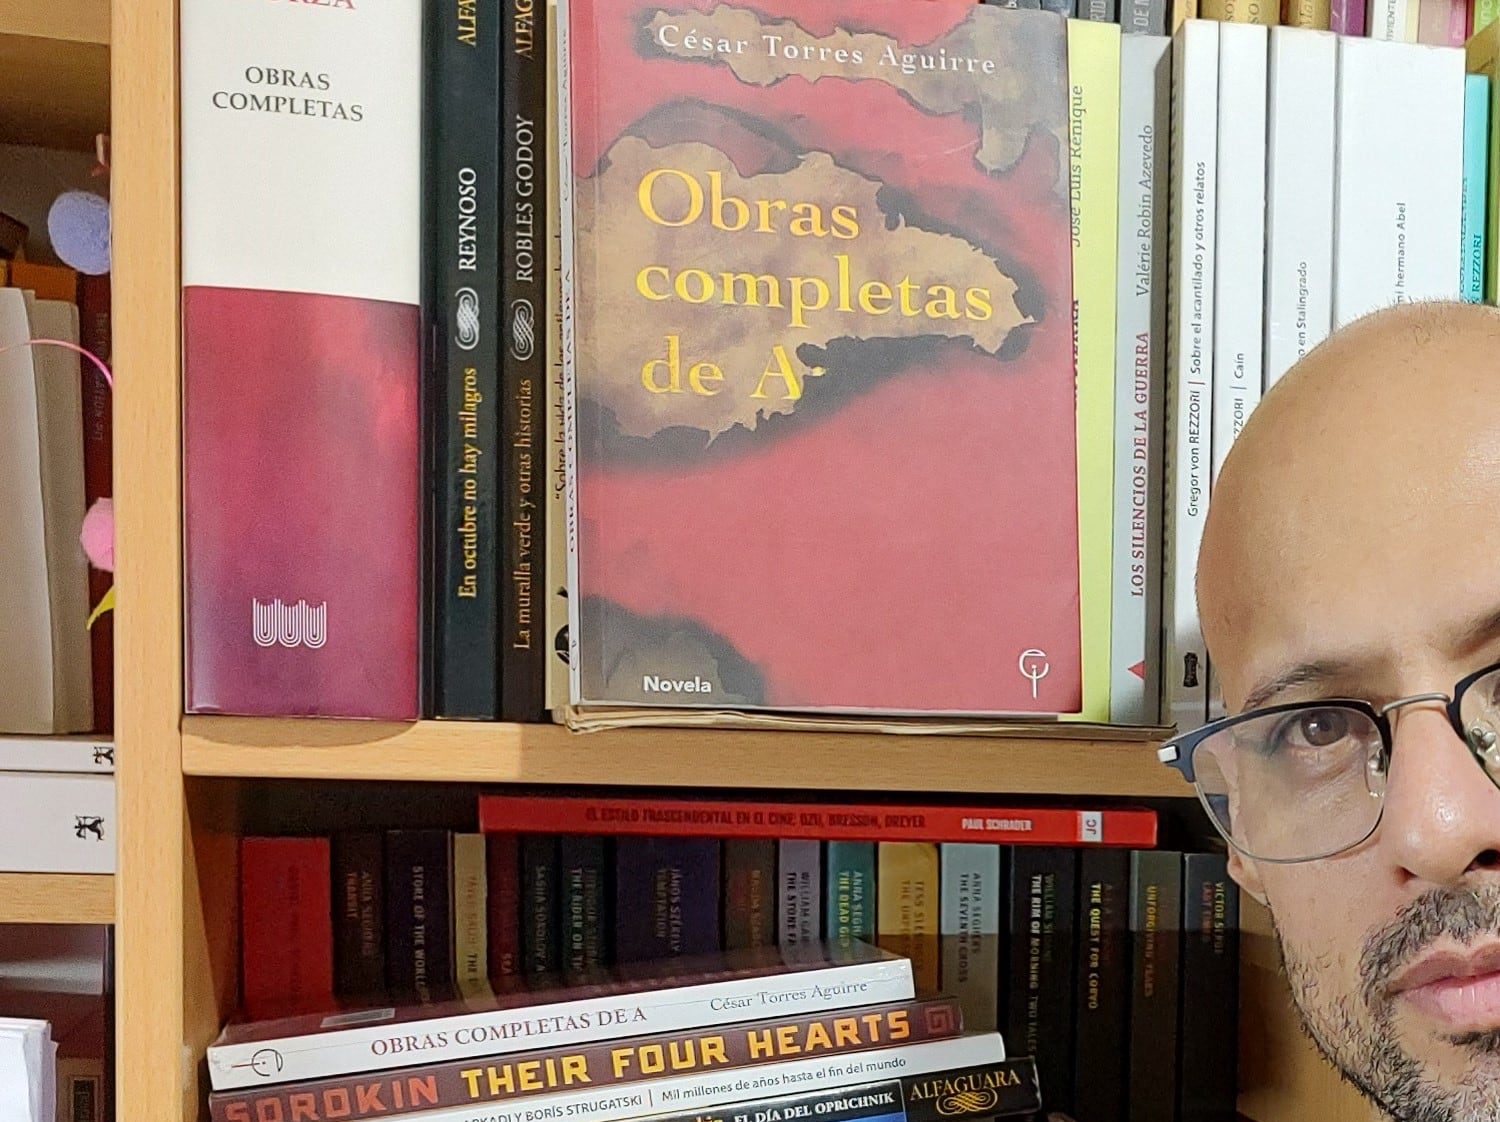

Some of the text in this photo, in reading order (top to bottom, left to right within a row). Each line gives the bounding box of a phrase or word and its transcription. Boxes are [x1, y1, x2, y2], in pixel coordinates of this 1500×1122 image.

[245, 66, 330, 91] OBRAS
[658, 24, 997, 76] César Torres Aguirre
[212, 91, 363, 122] COMPLETAS
[458, 168, 477, 271] REYNOSO
[515, 115, 534, 282] ROBLES GODOY
[637, 168, 861, 241] Obras
[1136, 124, 1154, 297] Valérie Robin Azevedo
[1189, 161, 1206, 375] Sobre el acantilado y otros relatos
[1394, 202, 1406, 288] hermano Abel
[635, 254, 994, 329] completas
[1295, 261, 1309, 329] Stalingrado
[641, 336, 723, 399] de
[457, 368, 483, 598] En octubre no hay milagros
[1131, 331, 1149, 598] LOS SILENCIOS DE LA GUERRA
[1187, 390, 1202, 517] Gregor von REZZORI
[512, 379, 537, 649] La muralla verde y otras historias
[642, 674, 713, 695] Novela
[961, 816, 985, 831] PAUL
[710, 981, 868, 1011] César Torres Aguirre
[370, 1007, 648, 1056] OBRAS COMPLETAS DE A
[461, 1054, 591, 1099] THEIR
[611, 1034, 728, 1079] FOUR
[747, 1010, 910, 1060] HEARTS
[514, 1112, 522, 1122] Y
[525, 1105, 564, 1122] BORÍS
[566, 1094, 642, 1116] STRUGATSKI
[662, 1057, 906, 1102] Mil millones de años hasta el fin del mundo
[783, 1105, 813, 1120] DEL
[814, 1092, 895, 1114] OPRICHNIK
[910, 1069, 1022, 1102] ALFAGUARA
